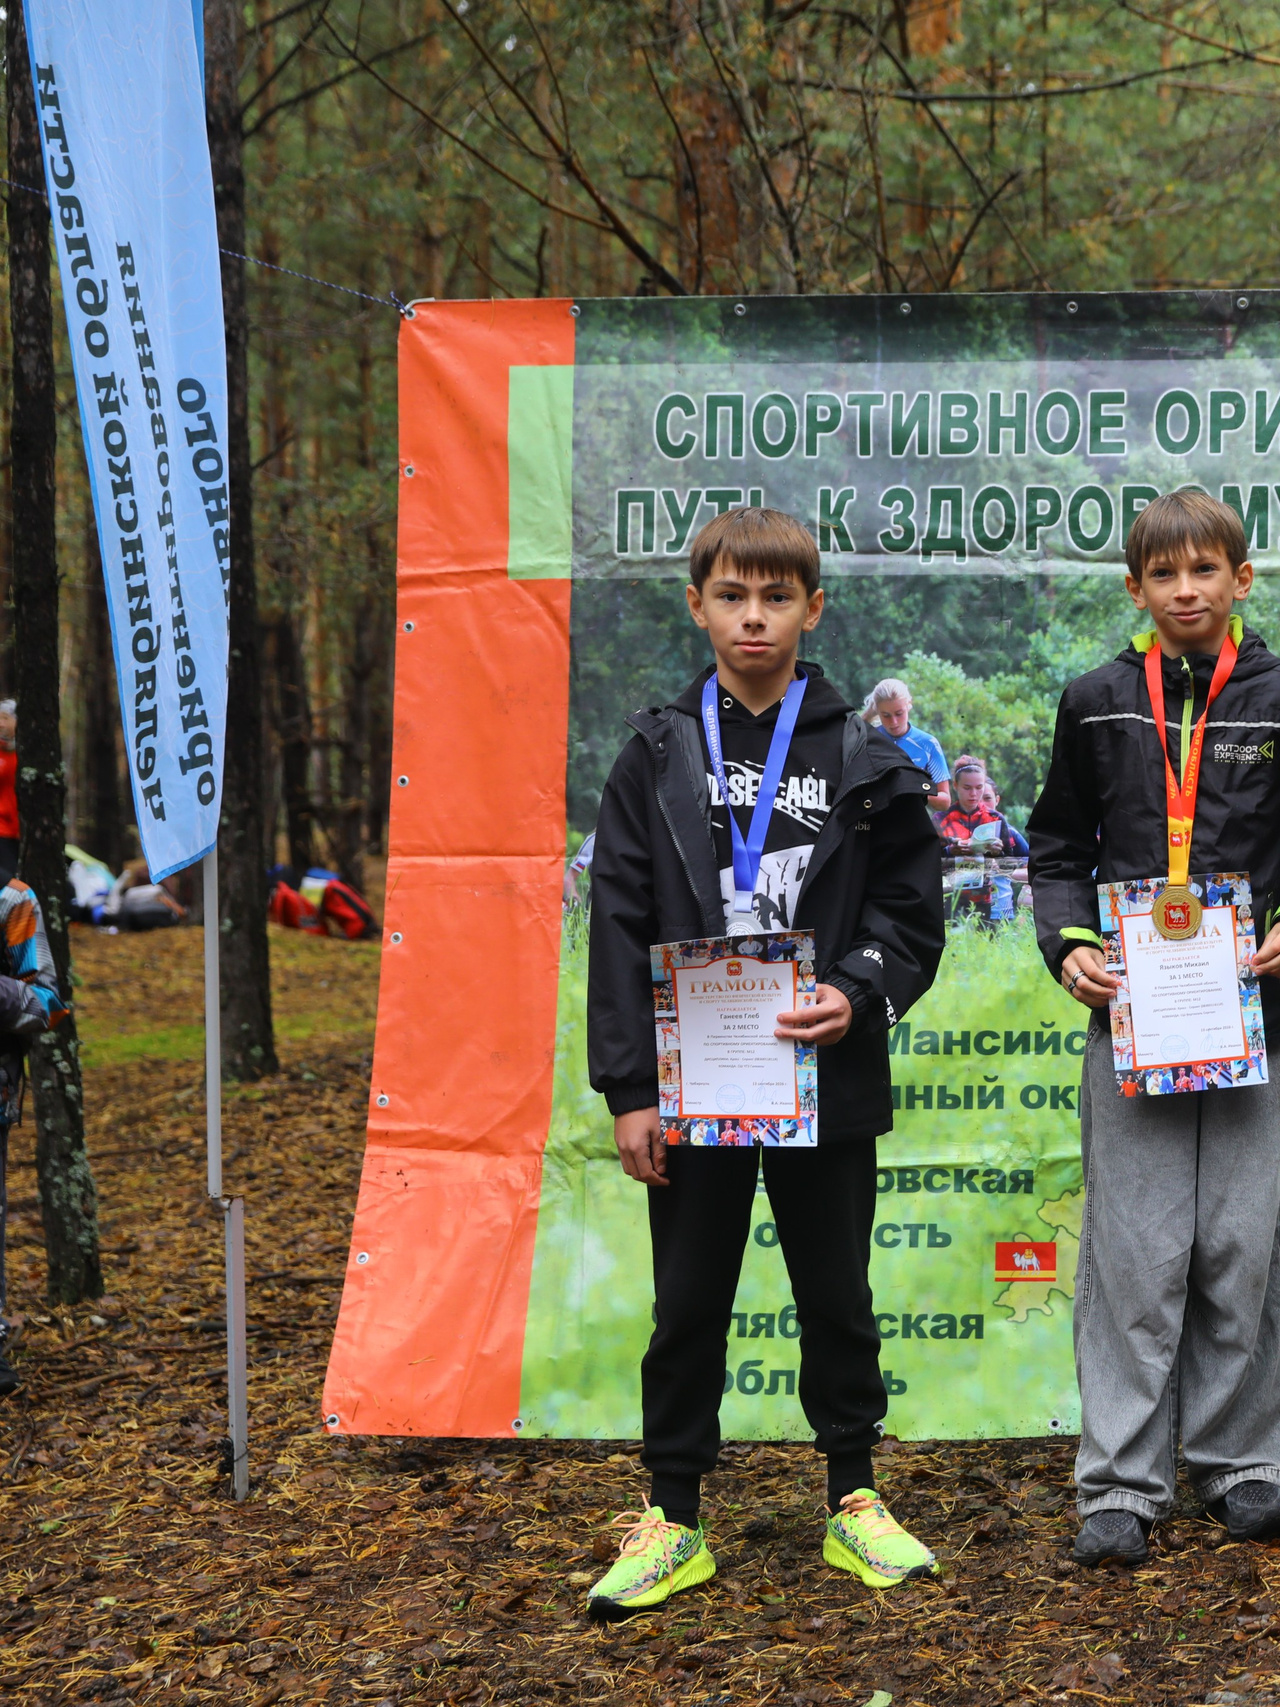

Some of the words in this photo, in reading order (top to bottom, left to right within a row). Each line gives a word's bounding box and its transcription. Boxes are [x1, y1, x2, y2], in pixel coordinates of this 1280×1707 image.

[654, 389, 1127, 460] СПОРТИВНОЕ
[817, 486, 856, 554] К
[706, 704, 723, 779] ЧЕЛЯБИНСКАЯ
[1214, 744, 1258, 754] OUTDOOR
[1214, 752, 1262, 760] EXPERIENCE
[1185, 747, 1199, 797] ОБЛАСТЬ
[690, 978, 781, 994] ГРАМОТА
